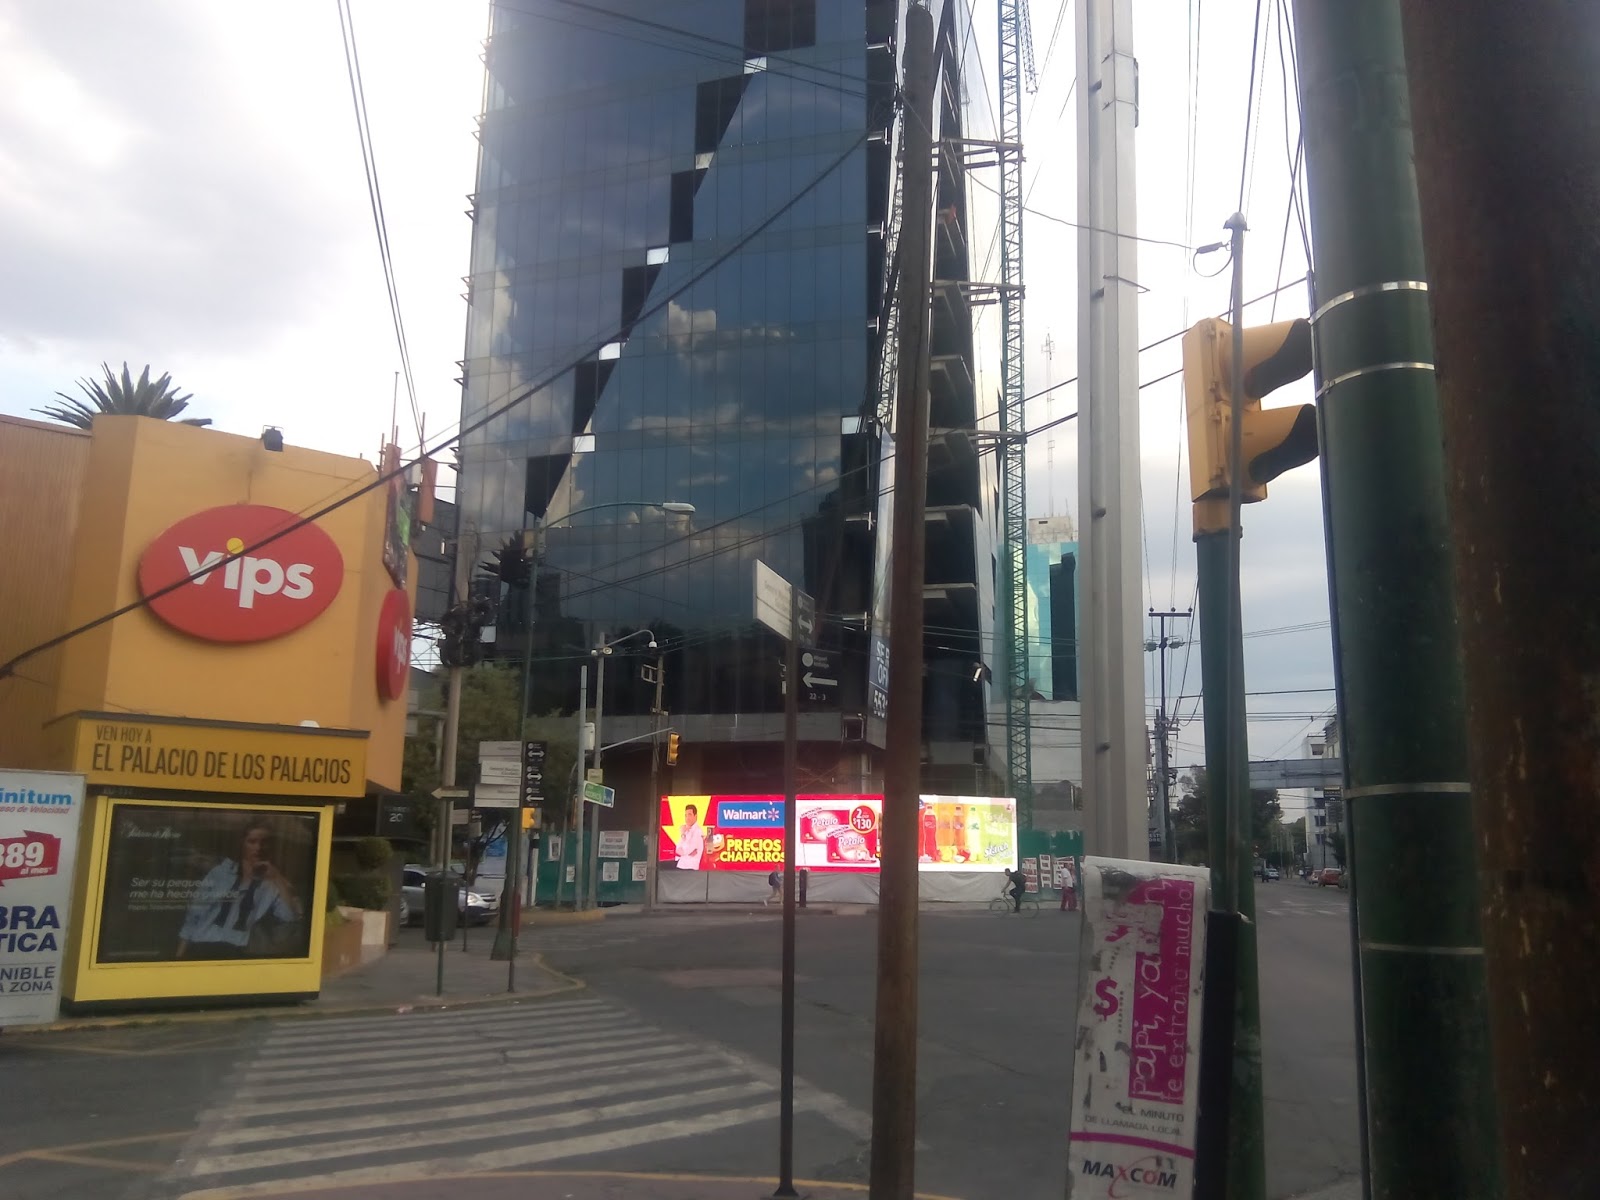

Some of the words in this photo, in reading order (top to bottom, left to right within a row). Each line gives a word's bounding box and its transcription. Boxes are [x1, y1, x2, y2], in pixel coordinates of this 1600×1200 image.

[178, 538, 314, 608] vips
[96, 725, 117, 741] VEN
[120, 727, 143, 743] HOY
[145, 728, 152, 744] A
[92, 743, 114, 771] EL
[120, 745, 198, 777] PALACIO
[204, 750, 228, 778] DE
[232, 752, 265, 780] LOS
[269, 755, 351, 784] PALACIOS
[30, 806, 70, 815] Velocidad
[723, 809, 767, 820] Walmart
[856, 809, 862, 818] 2
[853, 818, 871, 829] $130
[727, 839, 781, 852] PRECIOS
[20, 867, 29, 875] al
[131, 878, 149, 887] Ser
[152, 879, 164, 887] su
[130, 891, 147, 899] me
[151, 889, 164, 898] ha
[167, 890, 200, 899] hecho
[9, 981, 53, 993] ZONA
[1132, 1014, 1166, 1100] papi,
[1163, 1078, 1183, 1101] te
[1141, 1109, 1184, 1122] MINUTO
[1084, 1114, 1098, 1124] DE
[1101, 1117, 1149, 1132] LLAMADA
[1152, 1125, 1183, 1137] LOCAL
[1082, 1159, 1178, 1190] MAXCOM
